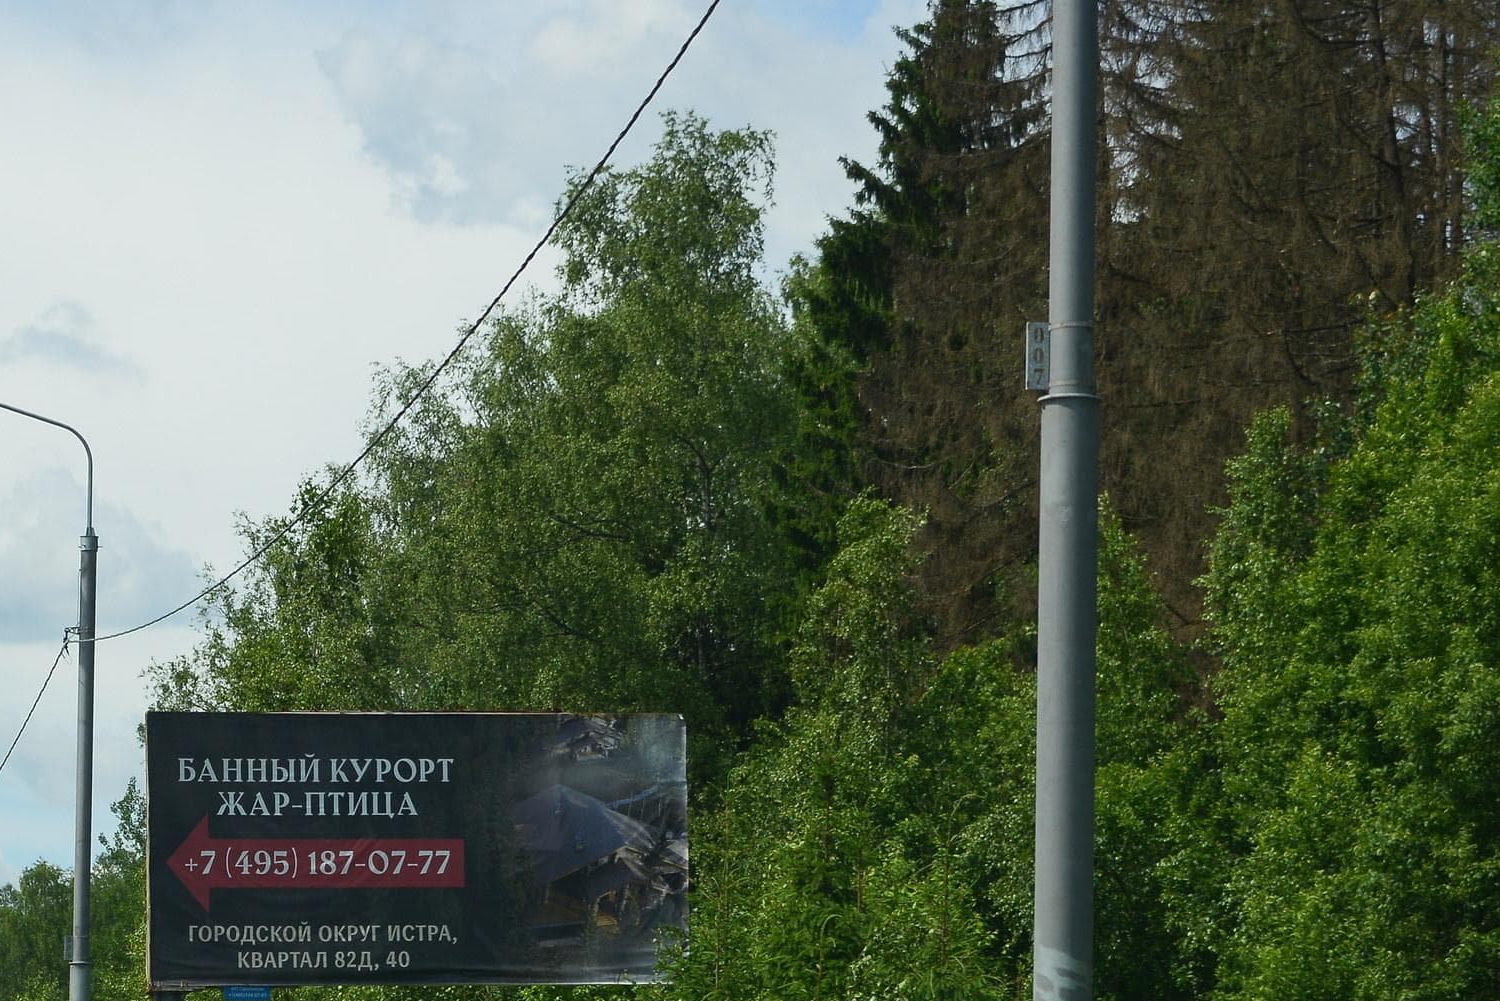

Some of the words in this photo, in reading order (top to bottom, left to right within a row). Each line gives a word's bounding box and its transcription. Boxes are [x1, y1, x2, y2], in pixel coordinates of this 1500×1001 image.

[178, 753, 321, 783] БАННЫЙ
[330, 758, 455, 783] КУРОРТ
[216, 791, 419, 819] ЖАР-ПТИЦА
[184, 850, 217, 875] +7
[225, 847, 299, 879] (495)
[307, 850, 452, 876] 187-07-77
[188, 921, 313, 946] ГОРОДСКОЙ
[318, 924, 381, 943] ОКРУГ
[387, 924, 459, 945] ИСТРА,
[237, 951, 329, 969] КВАРТАЛ
[334, 951, 381, 972] 82Д,
[386, 951, 411, 969] 40
